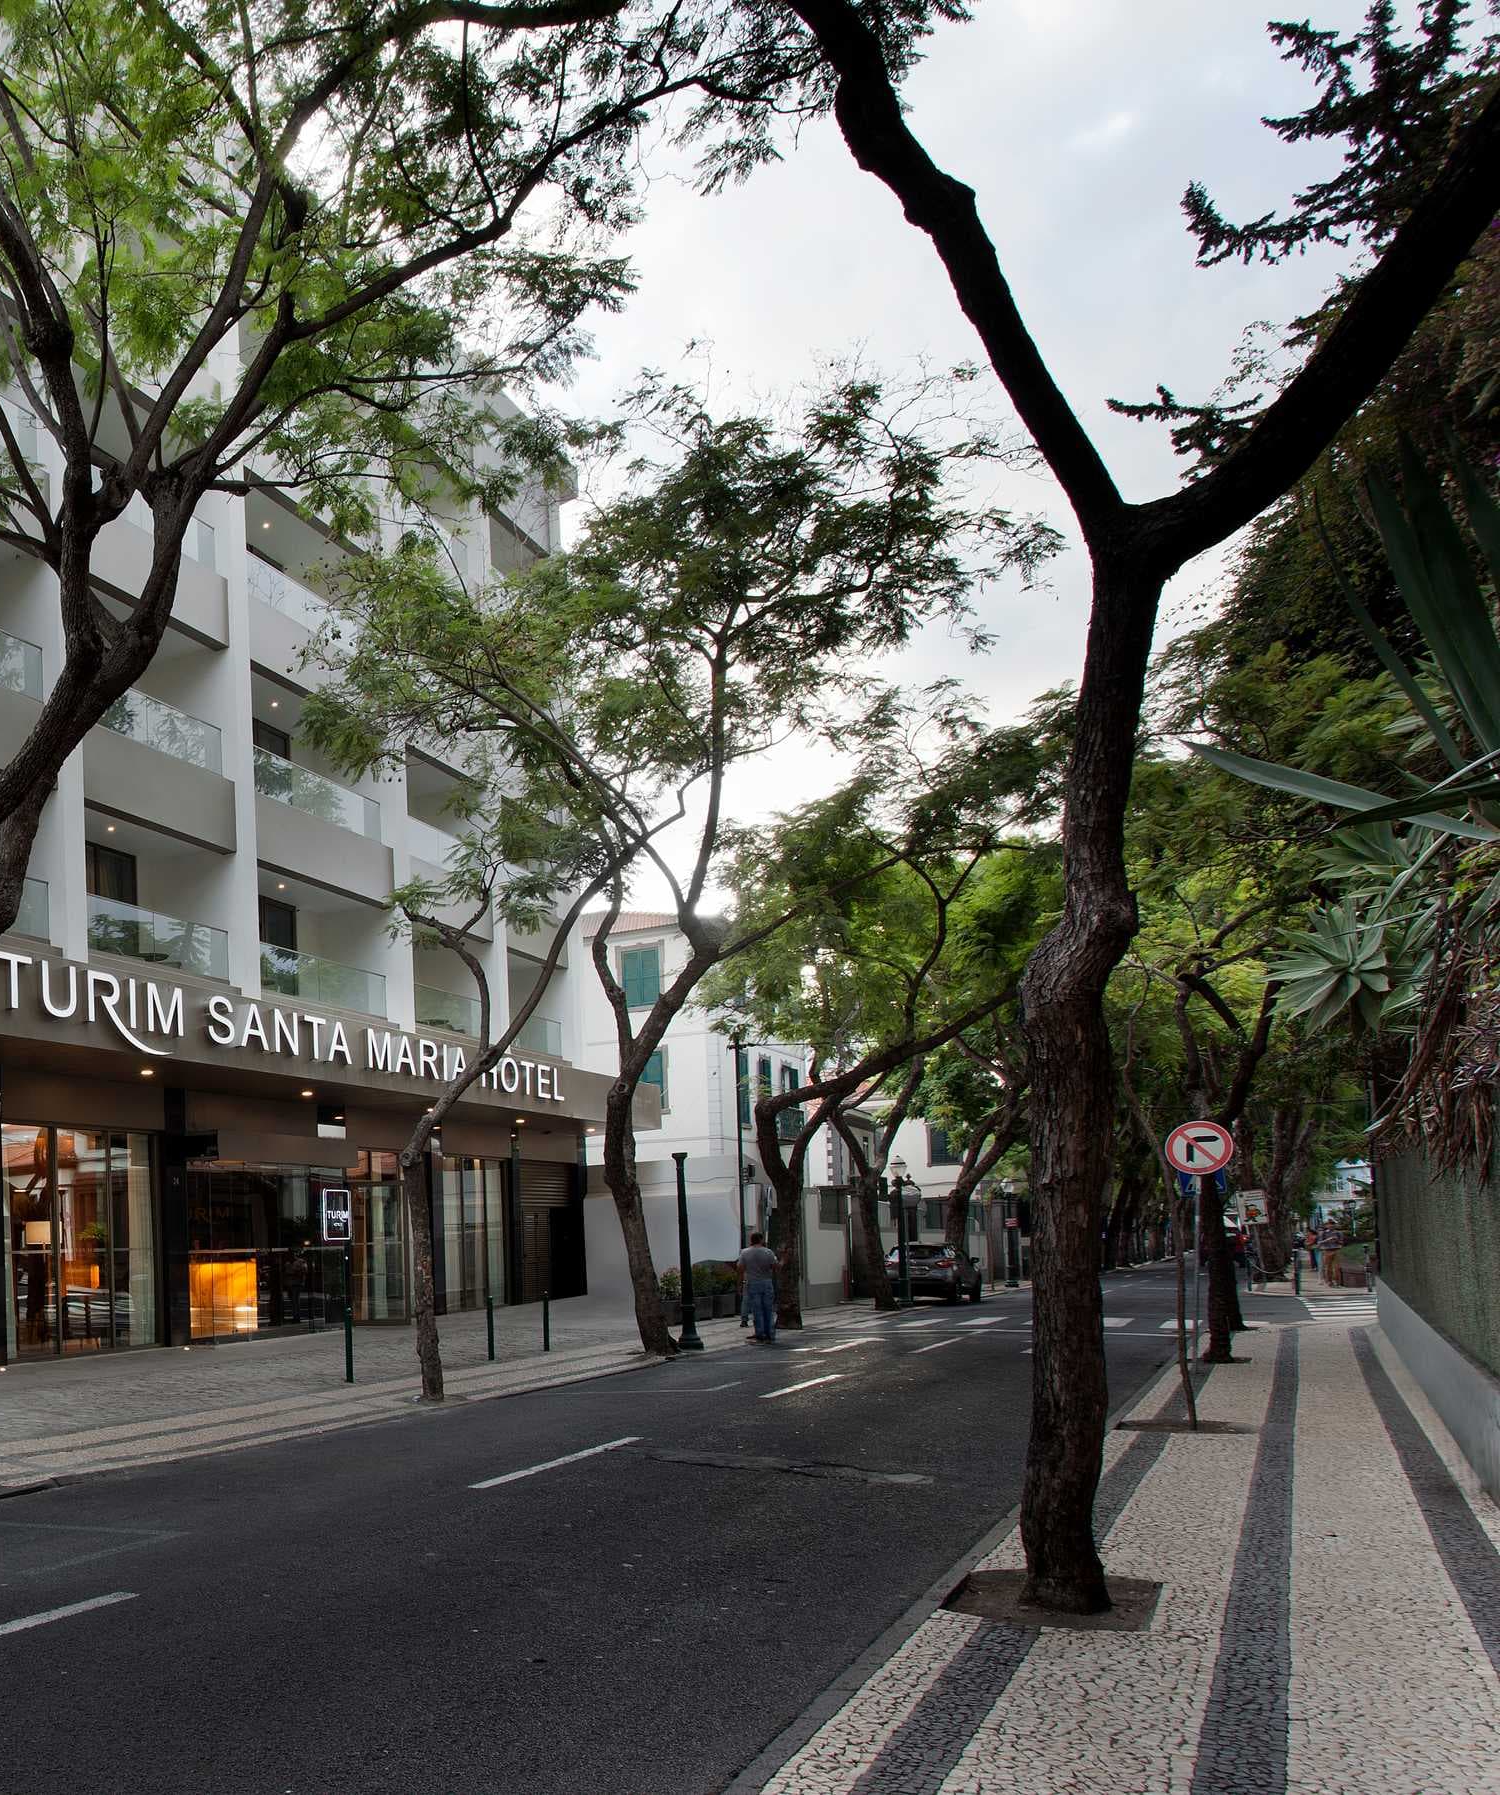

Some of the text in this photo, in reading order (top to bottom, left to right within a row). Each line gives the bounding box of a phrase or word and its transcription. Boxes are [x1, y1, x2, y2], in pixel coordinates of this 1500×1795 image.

[208, 995, 352, 1065] SANTA
[367, 1028, 467, 1081] MARIA
[327, 1210, 349, 1222] TURIM
